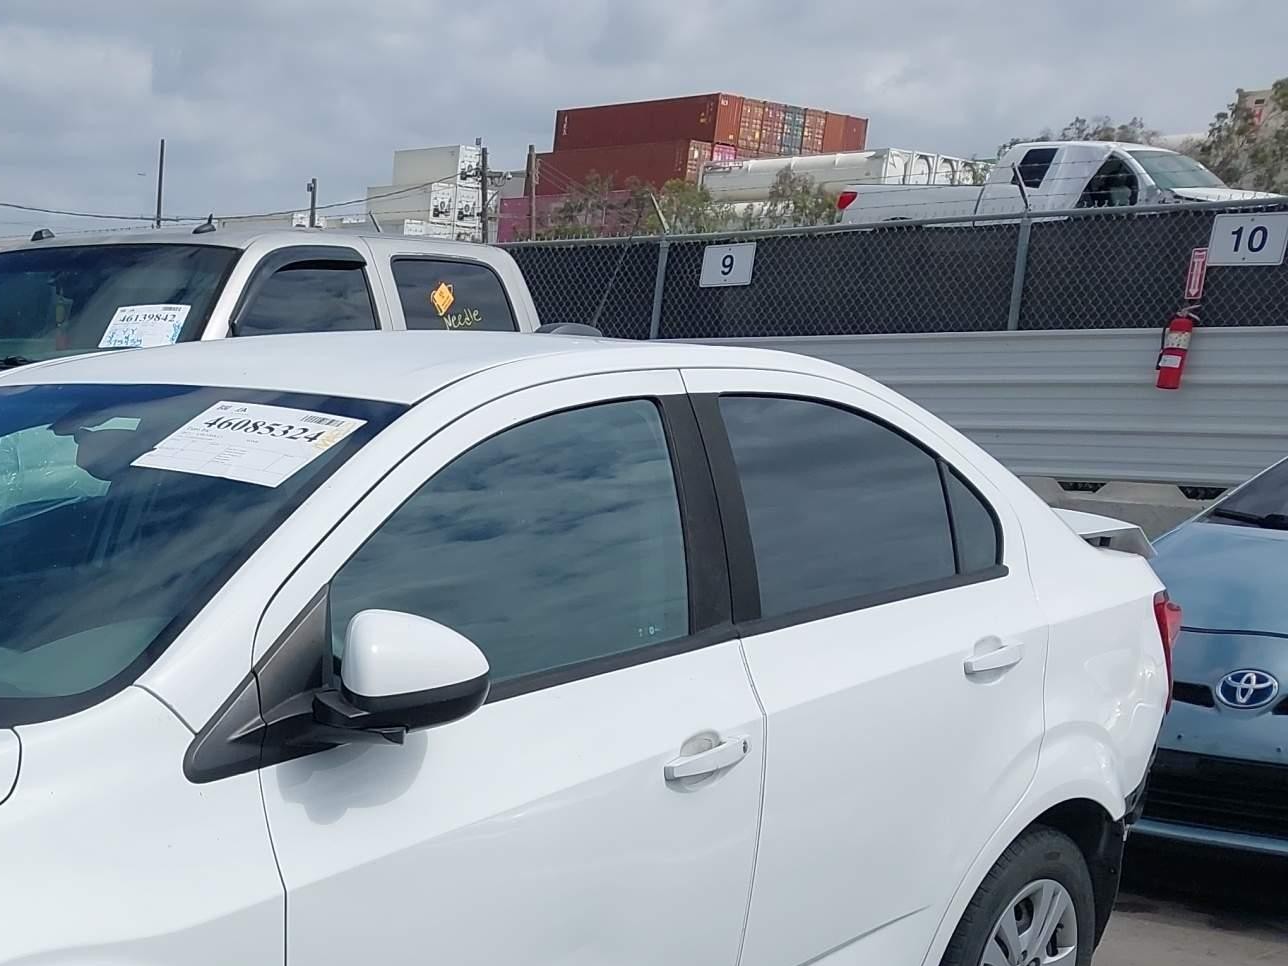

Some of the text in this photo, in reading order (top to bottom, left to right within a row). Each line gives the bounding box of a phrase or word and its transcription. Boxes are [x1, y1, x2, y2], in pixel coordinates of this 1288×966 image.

[1231, 226, 1268, 253] 10
[721, 254, 734, 276] 9
[119, 312, 177, 323] 46139842
[204, 416, 326, 443] 46085324
